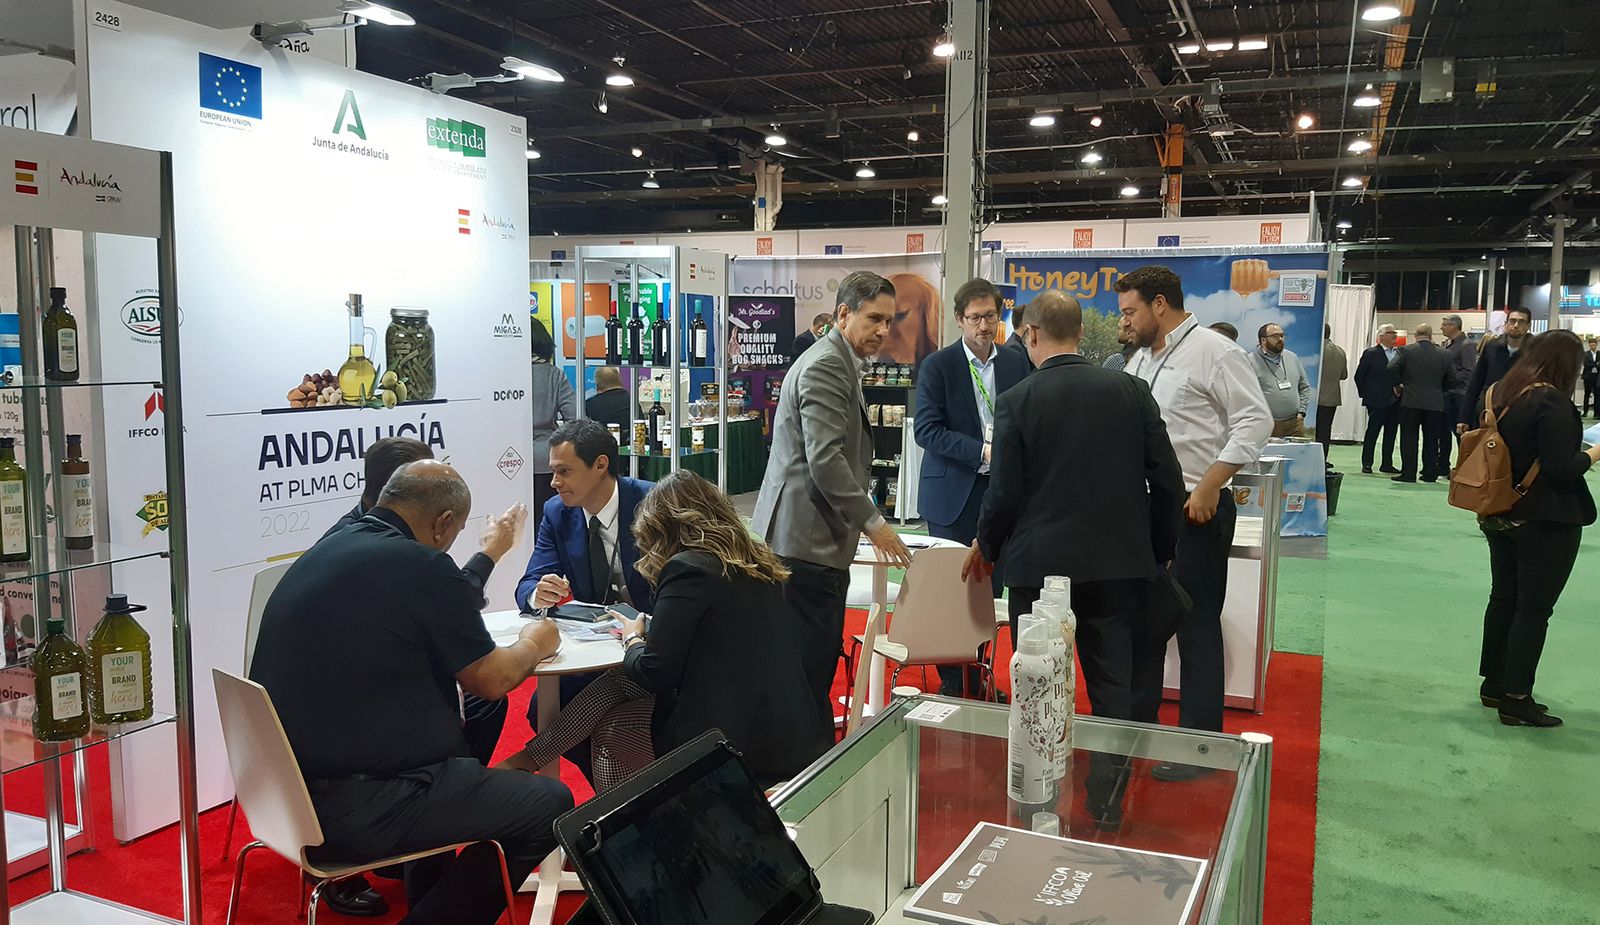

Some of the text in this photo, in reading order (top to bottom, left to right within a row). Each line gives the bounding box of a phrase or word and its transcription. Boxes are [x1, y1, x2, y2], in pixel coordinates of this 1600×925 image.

[96, 12, 120, 27] 2428
[200, 110, 252, 127] EUROPEAN UNION
[428, 125, 484, 151] extenda
[312, 136, 336, 150] Junta
[338, 141, 348, 152] de
[60, 167, 122, 192] Andalucía
[1075, 231, 1092, 241] ENJOY
[1262, 225, 1281, 236] ENJOY
[494, 325, 522, 335] MIGASA
[738, 333, 777, 343] PREMIUM
[740, 343, 775, 354] QUALITY
[732, 354, 784, 365] DOG SNACKS
[128, 427, 159, 439] IFFCO
[500, 459, 521, 469] crespo
[260, 472, 365, 503] AT PLMA CH
[4, 505, 22, 515] BRAND
[260, 510, 311, 538] 2022
[111, 656, 134, 666] YOUR
[57, 676, 75, 685] YOUR
[112, 674, 136, 684] BRAND
[58, 689, 76, 698] BRAND
[1061, 870, 1093, 901] Olive Oil
